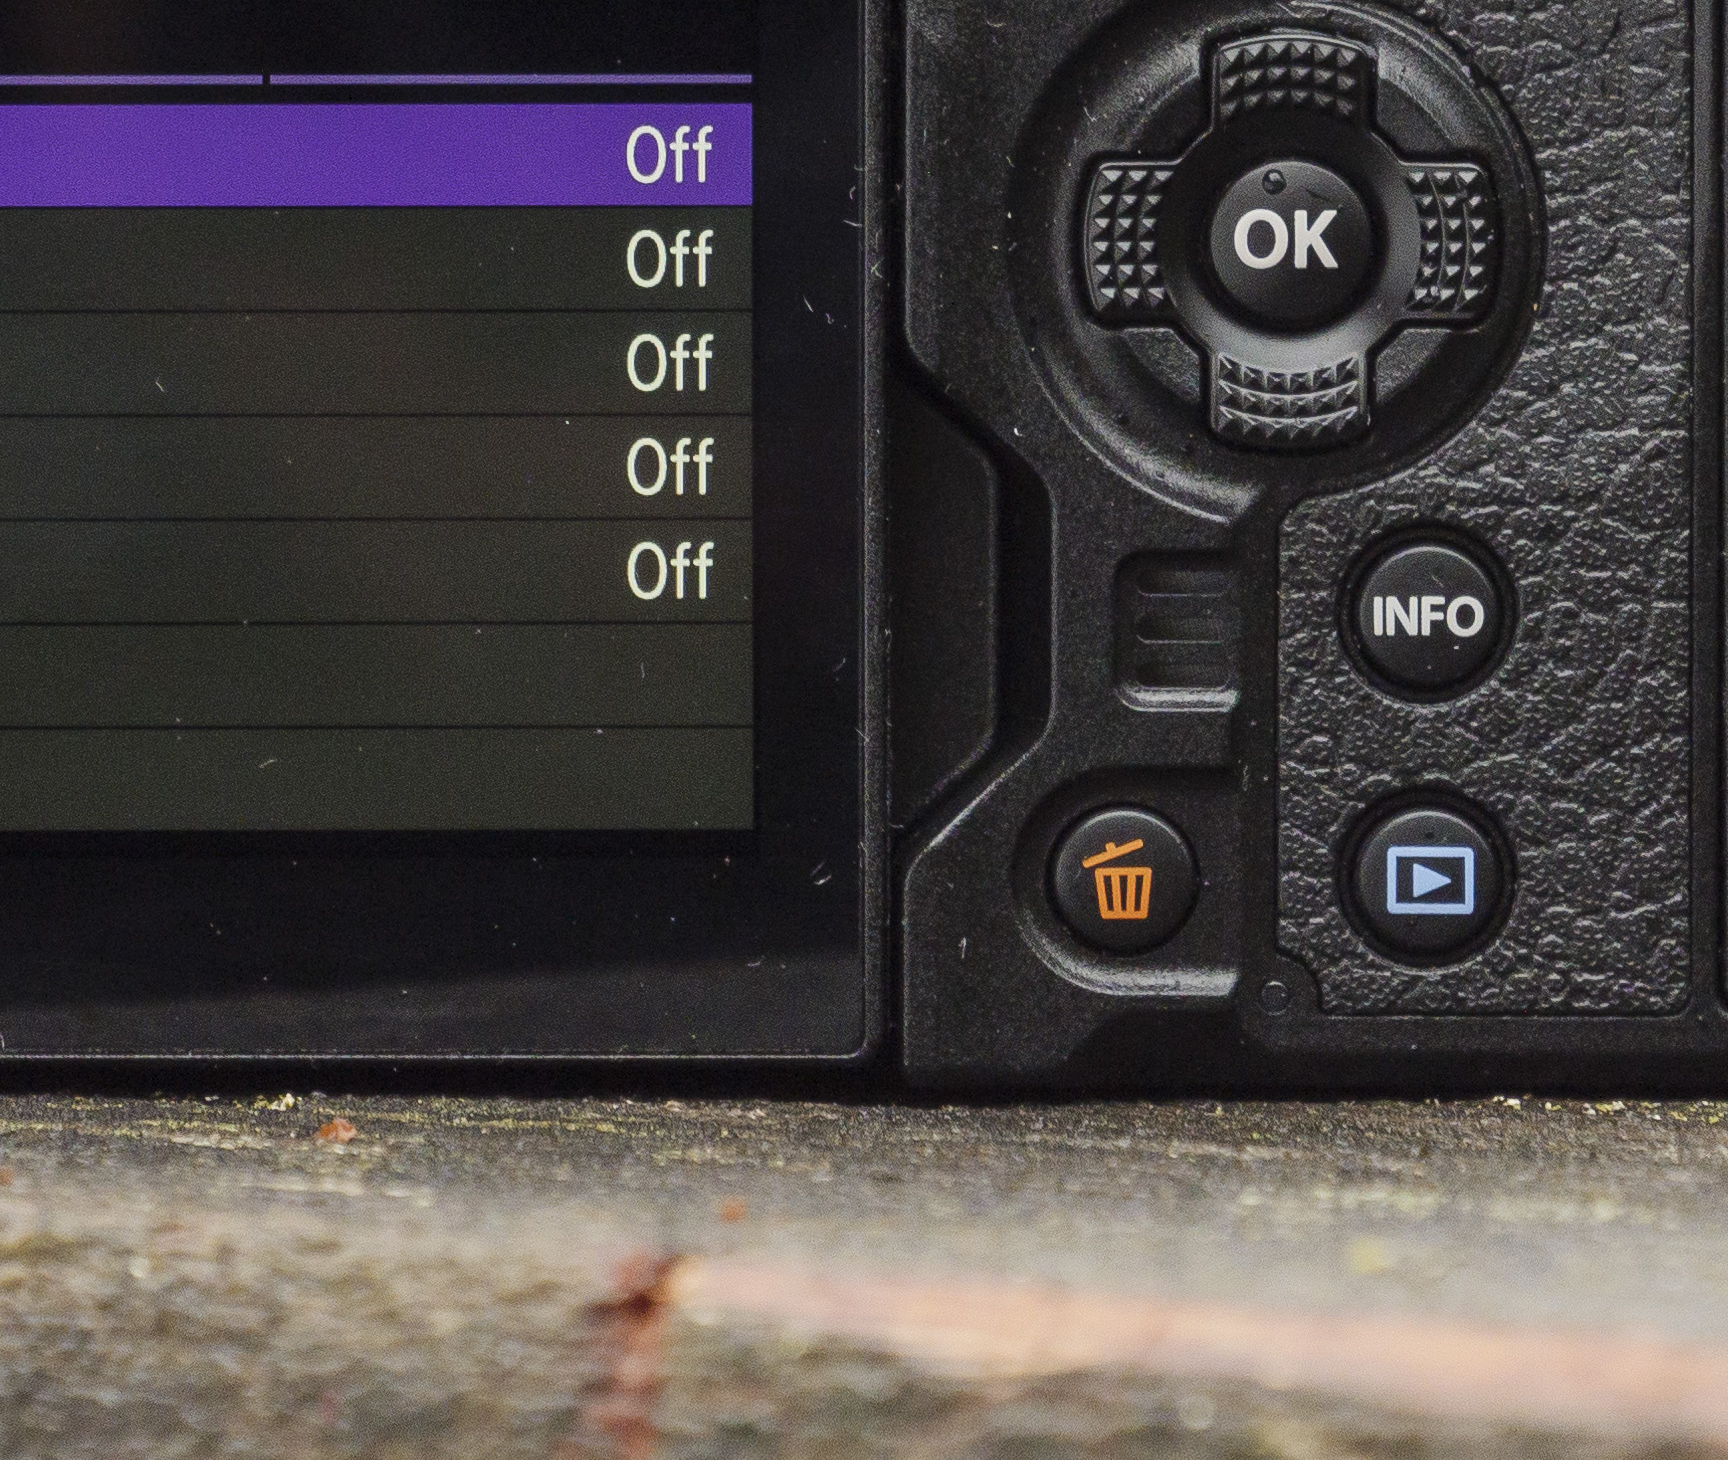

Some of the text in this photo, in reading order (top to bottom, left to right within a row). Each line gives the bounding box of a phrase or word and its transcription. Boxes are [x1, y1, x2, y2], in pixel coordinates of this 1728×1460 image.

[626, 125, 714, 185] Off
[626, 229, 714, 288] Off
[1233, 207, 1339, 270] OK
[626, 333, 715, 392] Off
[626, 437, 715, 497] Off
[626, 541, 715, 601] Off
[1373, 595, 1485, 638] INFO
